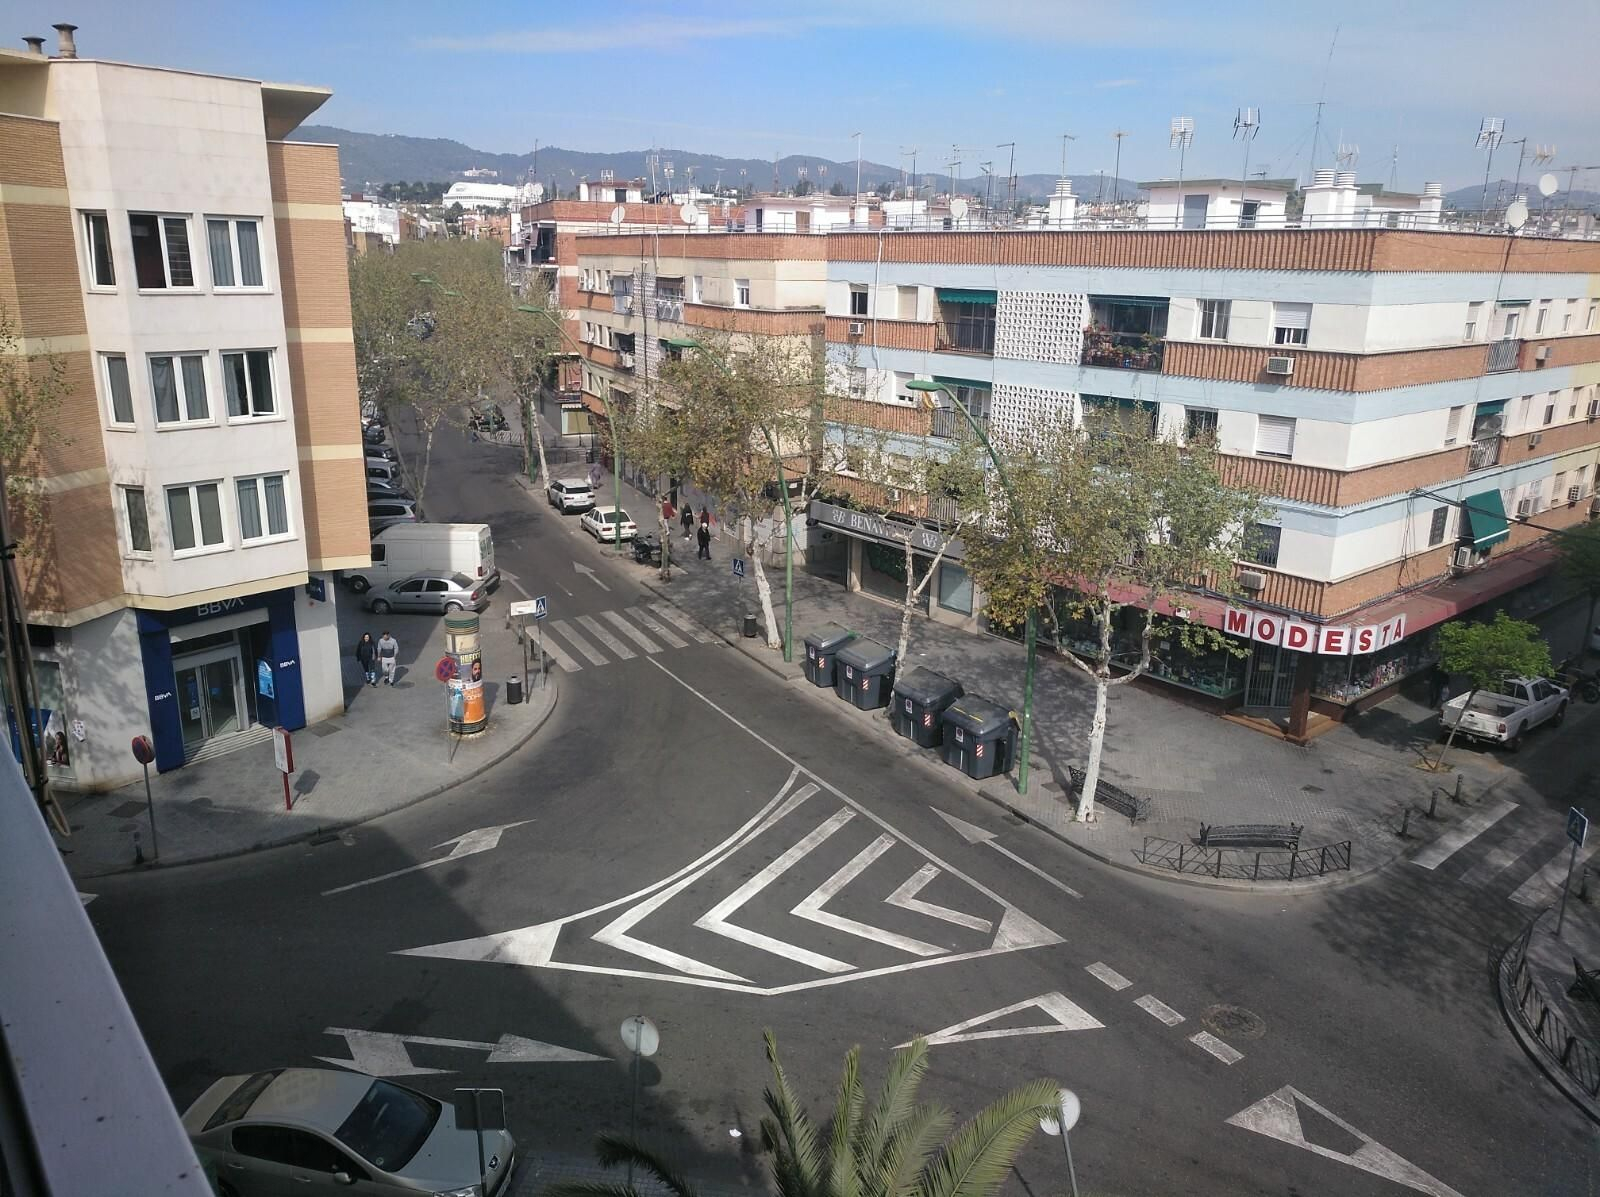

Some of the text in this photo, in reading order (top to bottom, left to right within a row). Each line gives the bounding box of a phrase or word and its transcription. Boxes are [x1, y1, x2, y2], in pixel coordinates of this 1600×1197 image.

[198, 597, 244, 616] BBVA
[1228, 610, 1402, 652] MODESTA
[279, 659, 296, 669] BBVA
[154, 691, 172, 702] BBVA
